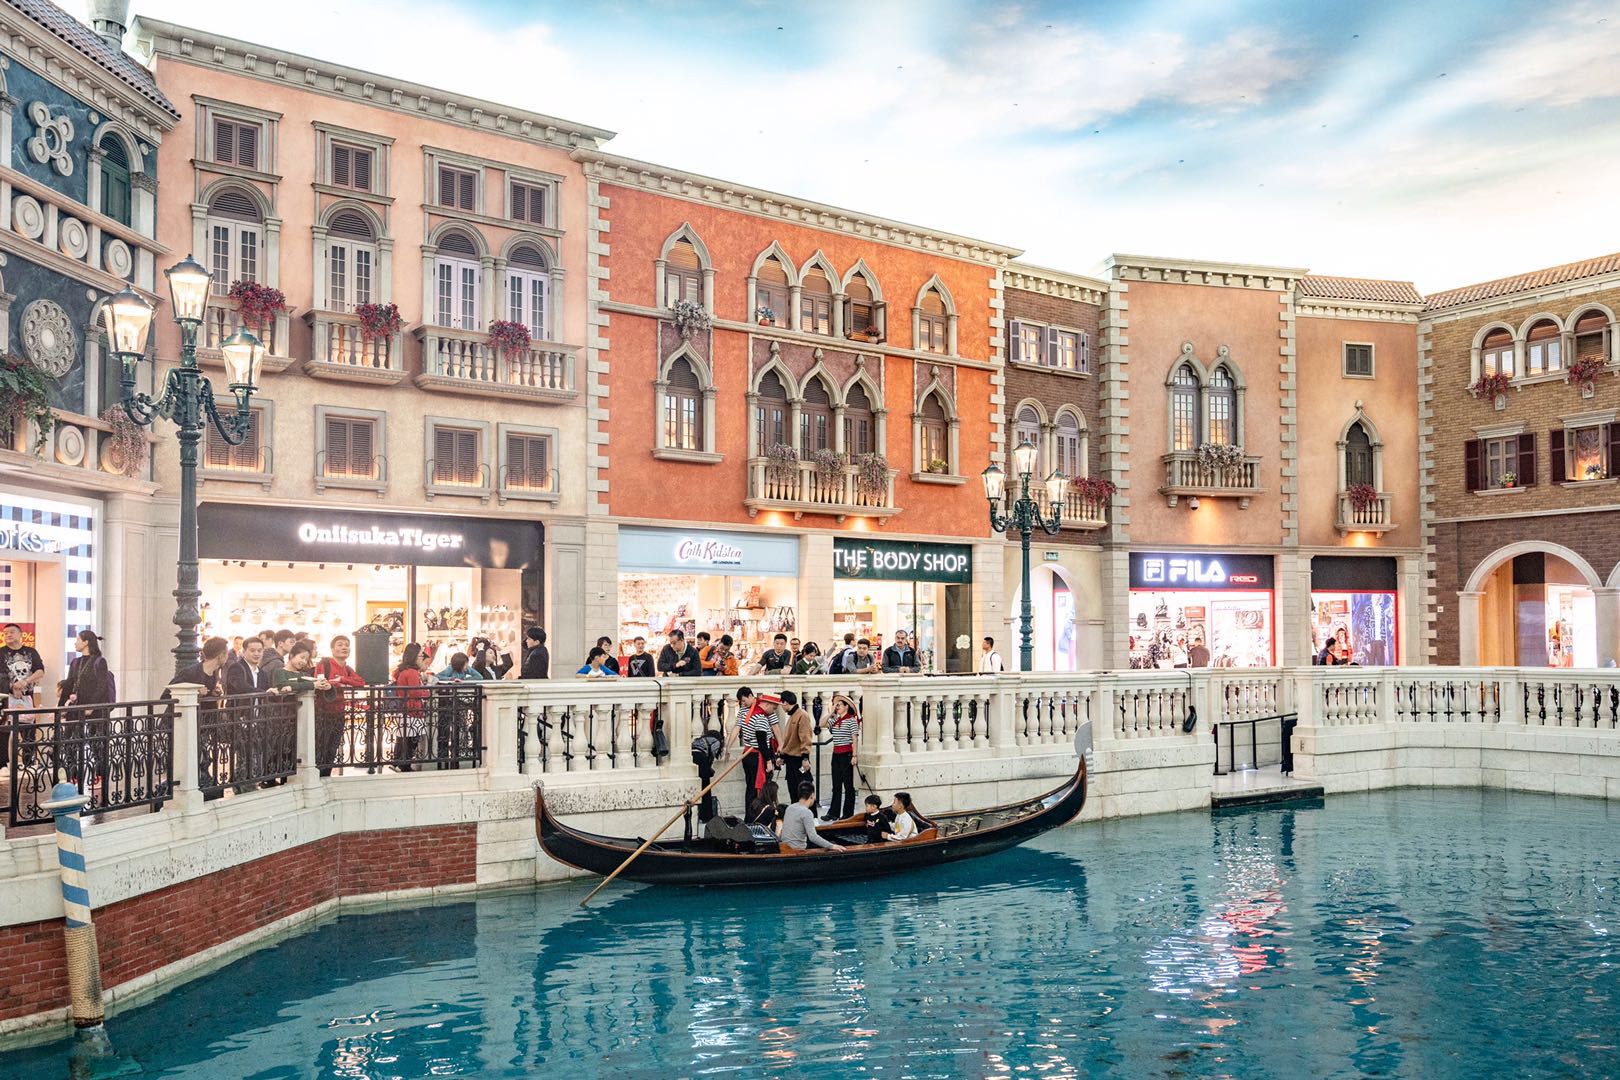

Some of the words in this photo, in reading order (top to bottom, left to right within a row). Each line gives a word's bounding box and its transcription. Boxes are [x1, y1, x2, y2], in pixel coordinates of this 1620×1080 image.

[833, 548, 867, 569] THE
[872, 551, 921, 570] BODY
[1168, 559, 1226, 582] FILA
